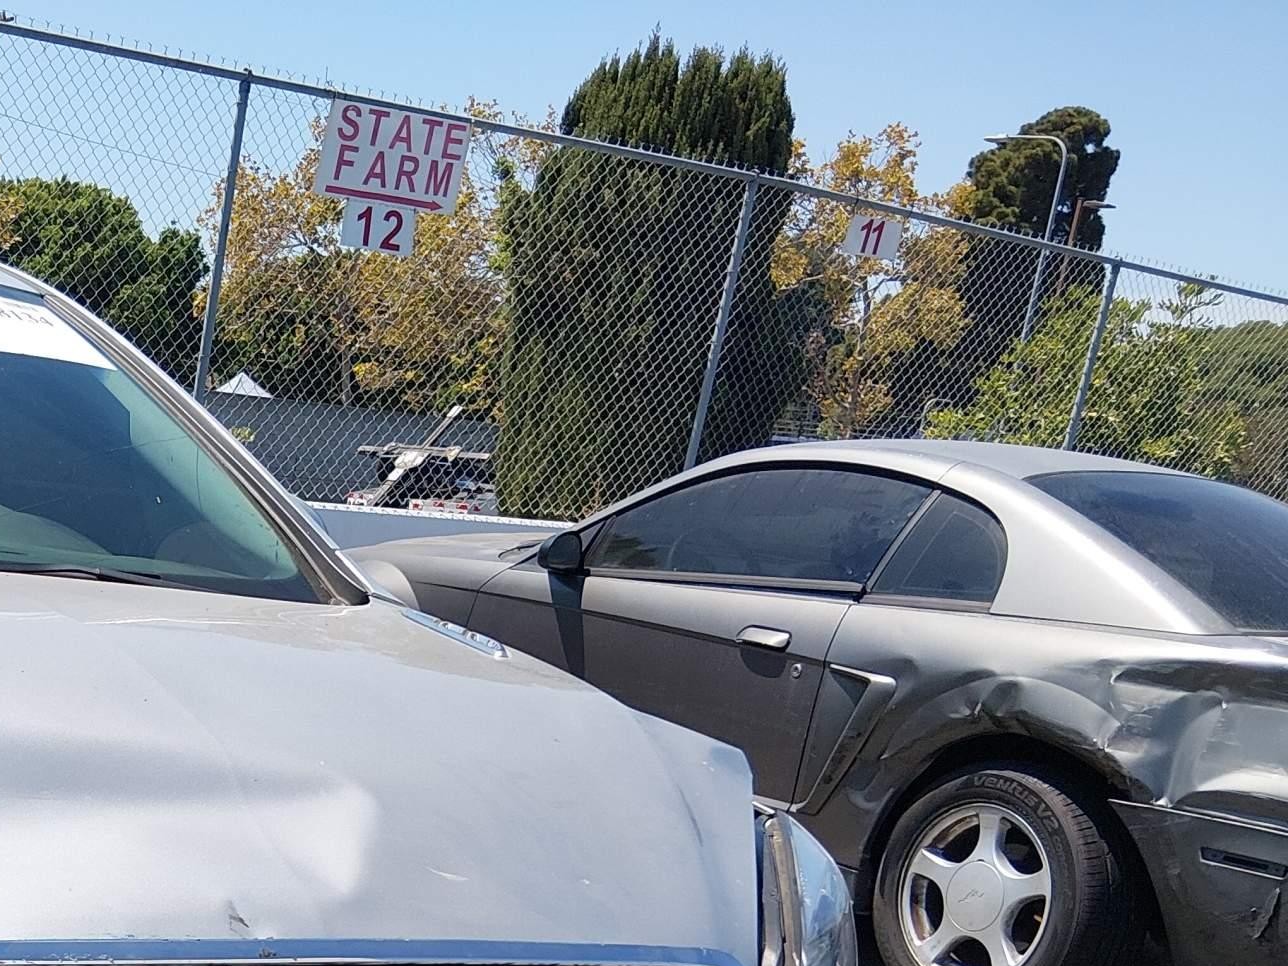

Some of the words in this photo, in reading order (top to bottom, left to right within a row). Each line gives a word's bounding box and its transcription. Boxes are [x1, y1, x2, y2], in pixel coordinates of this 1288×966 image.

[337, 104, 467, 161] STATE
[333, 144, 454, 198] FARM
[357, 206, 404, 252] 12
[860, 218, 886, 256] 11
